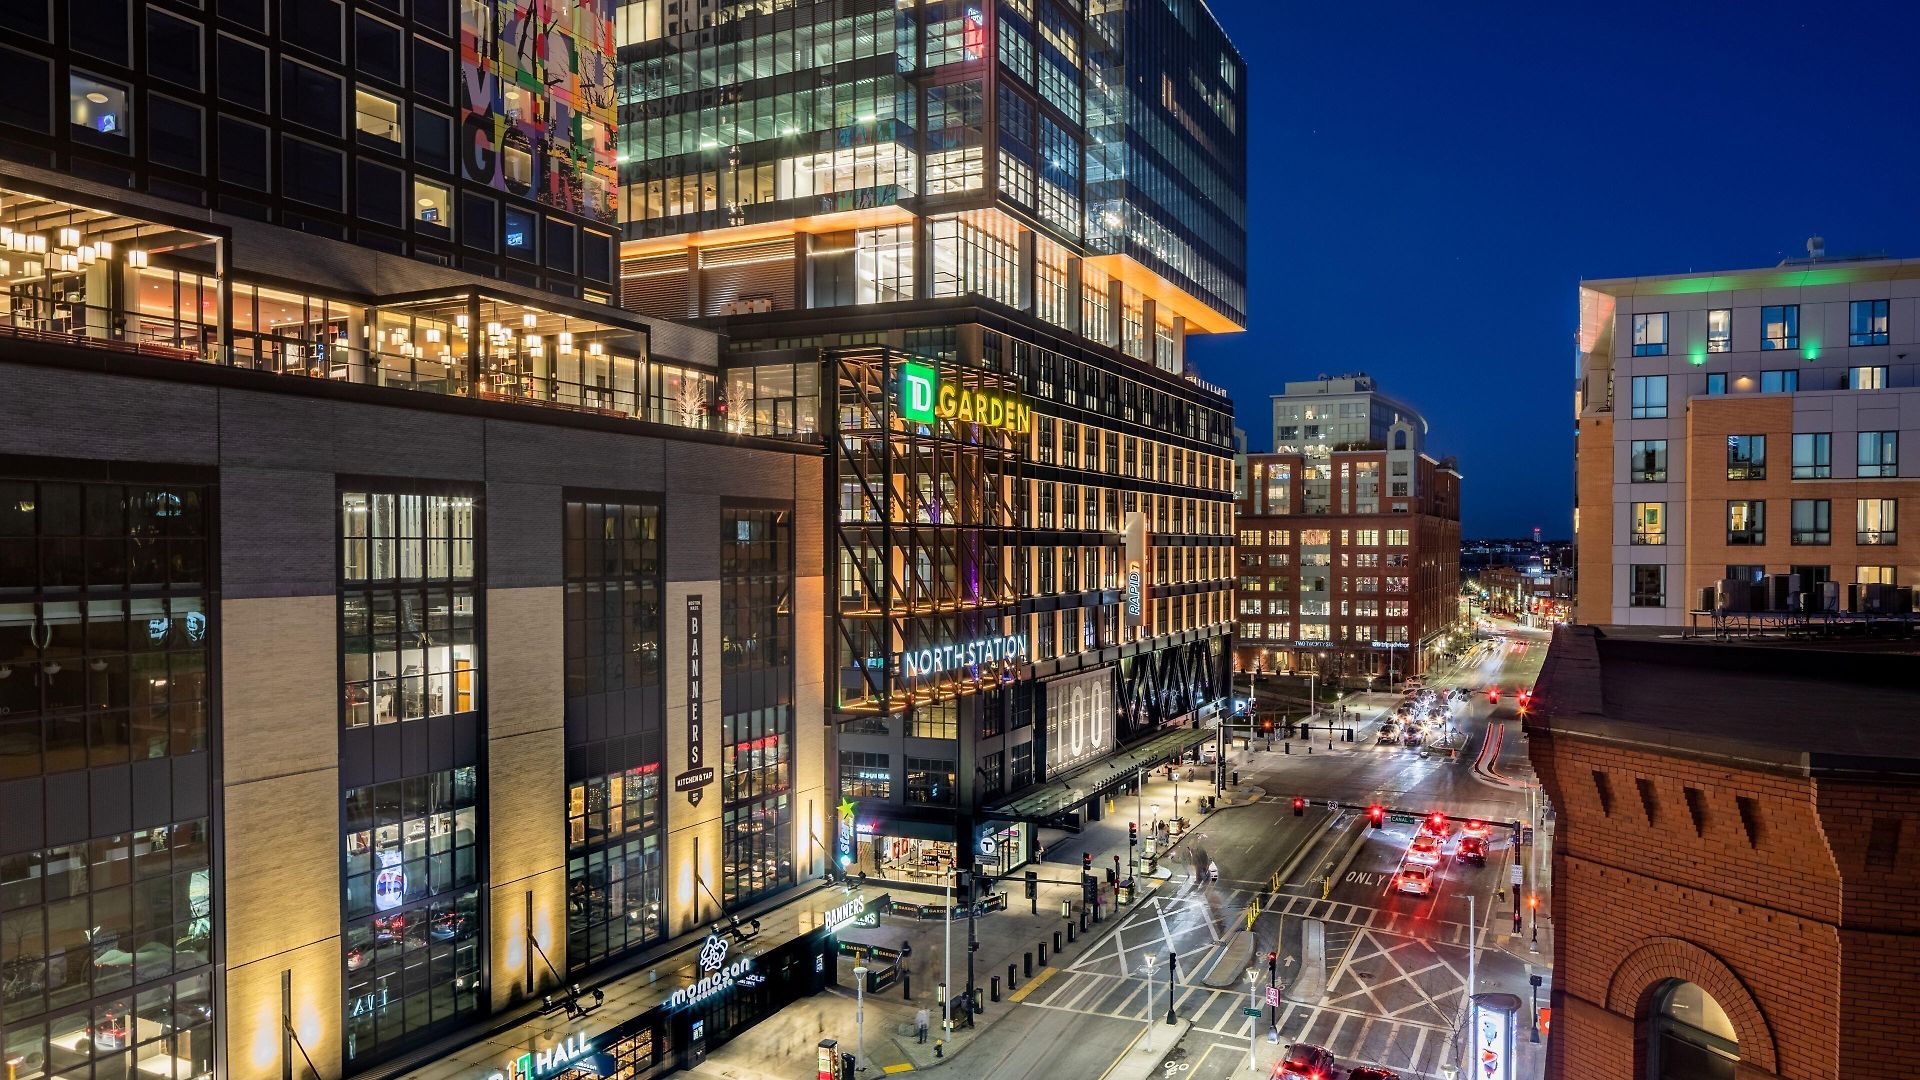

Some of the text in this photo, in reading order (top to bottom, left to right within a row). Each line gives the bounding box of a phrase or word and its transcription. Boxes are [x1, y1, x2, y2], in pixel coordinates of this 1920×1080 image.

[907, 374, 1031, 433] TD GARDEN
[905, 634, 1027, 678] NORTH STATION
[691, 617, 699, 763] BANNERS
[1057, 681, 1103, 763] 100
[677, 774, 699, 787] KITCHEN
[703, 771, 713, 780] TAP
[1346, 871, 1385, 887] ONLY
[825, 895, 864, 932] BANNERS
[672, 959, 750, 1007] momosan
[537, 1032, 592, 1074] HALL
